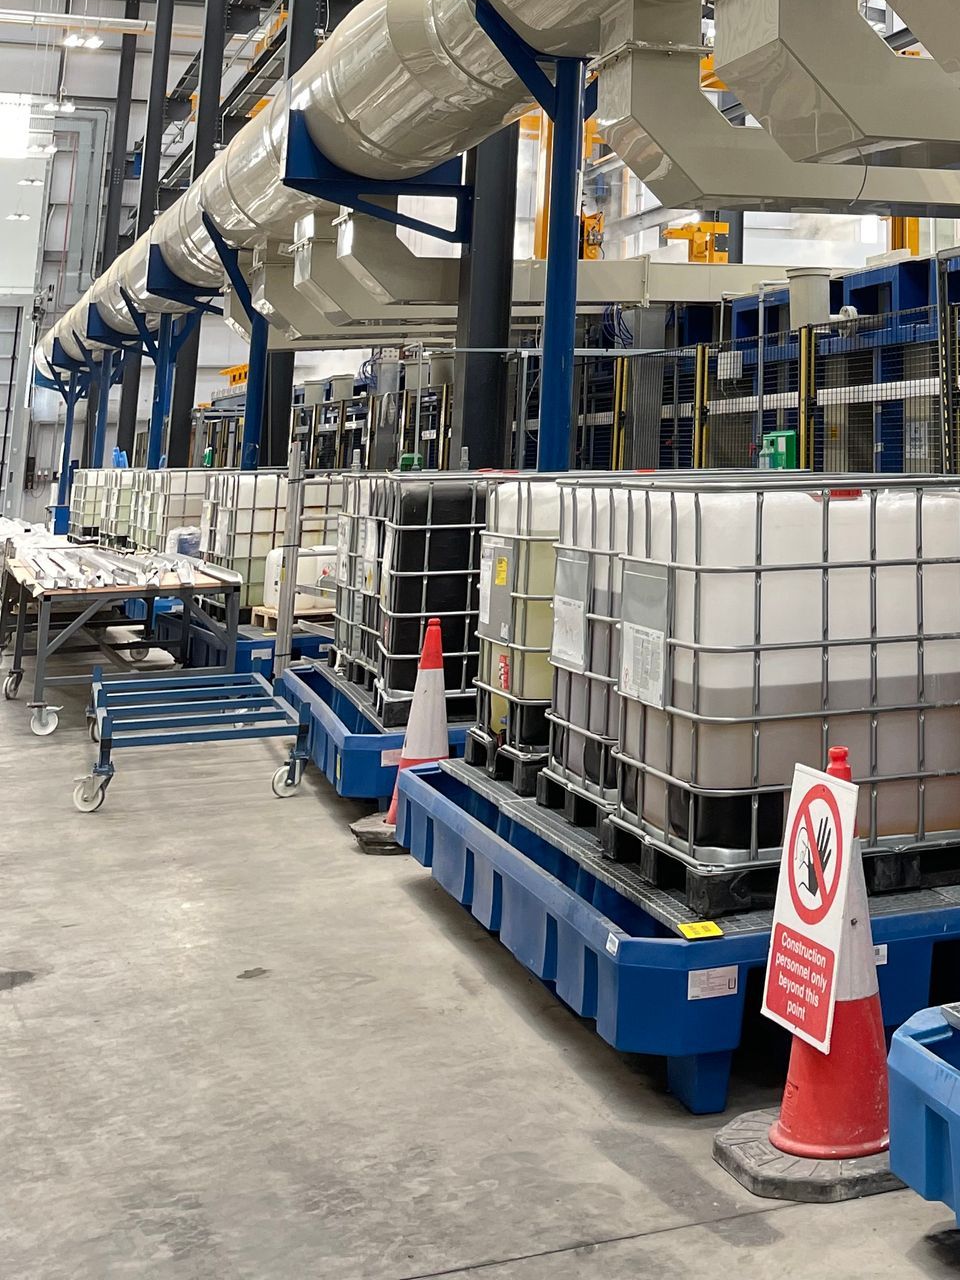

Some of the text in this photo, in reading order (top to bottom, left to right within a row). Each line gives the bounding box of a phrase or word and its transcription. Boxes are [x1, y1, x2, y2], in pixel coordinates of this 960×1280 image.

[781, 931, 826, 968] Construction
[775, 952, 828, 993] personnel only
[778, 971, 819, 1008] beyond this
[786, 999, 806, 1021] point
